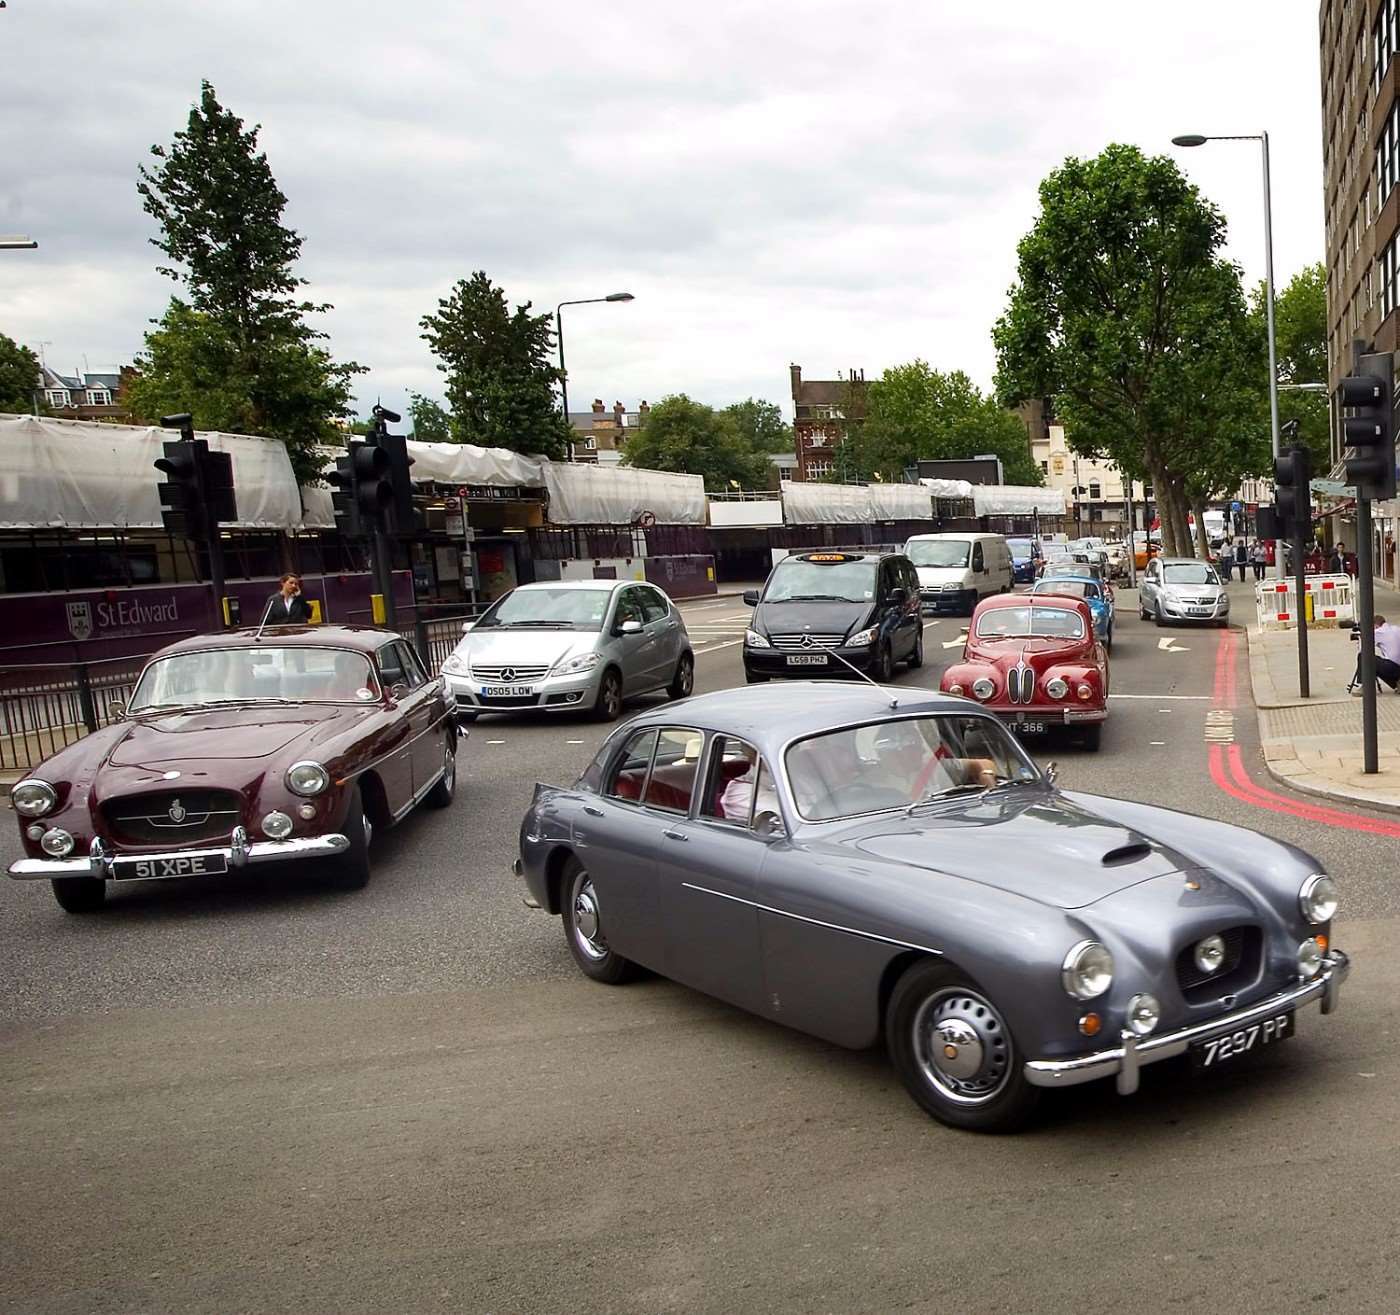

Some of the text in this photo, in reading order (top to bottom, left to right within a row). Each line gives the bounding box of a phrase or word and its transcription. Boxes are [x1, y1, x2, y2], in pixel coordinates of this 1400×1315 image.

[97, 596, 179, 627] St Edward
[136, 857, 207, 878] 51 XPE
[1203, 1015, 1289, 1067] 7297 PP
